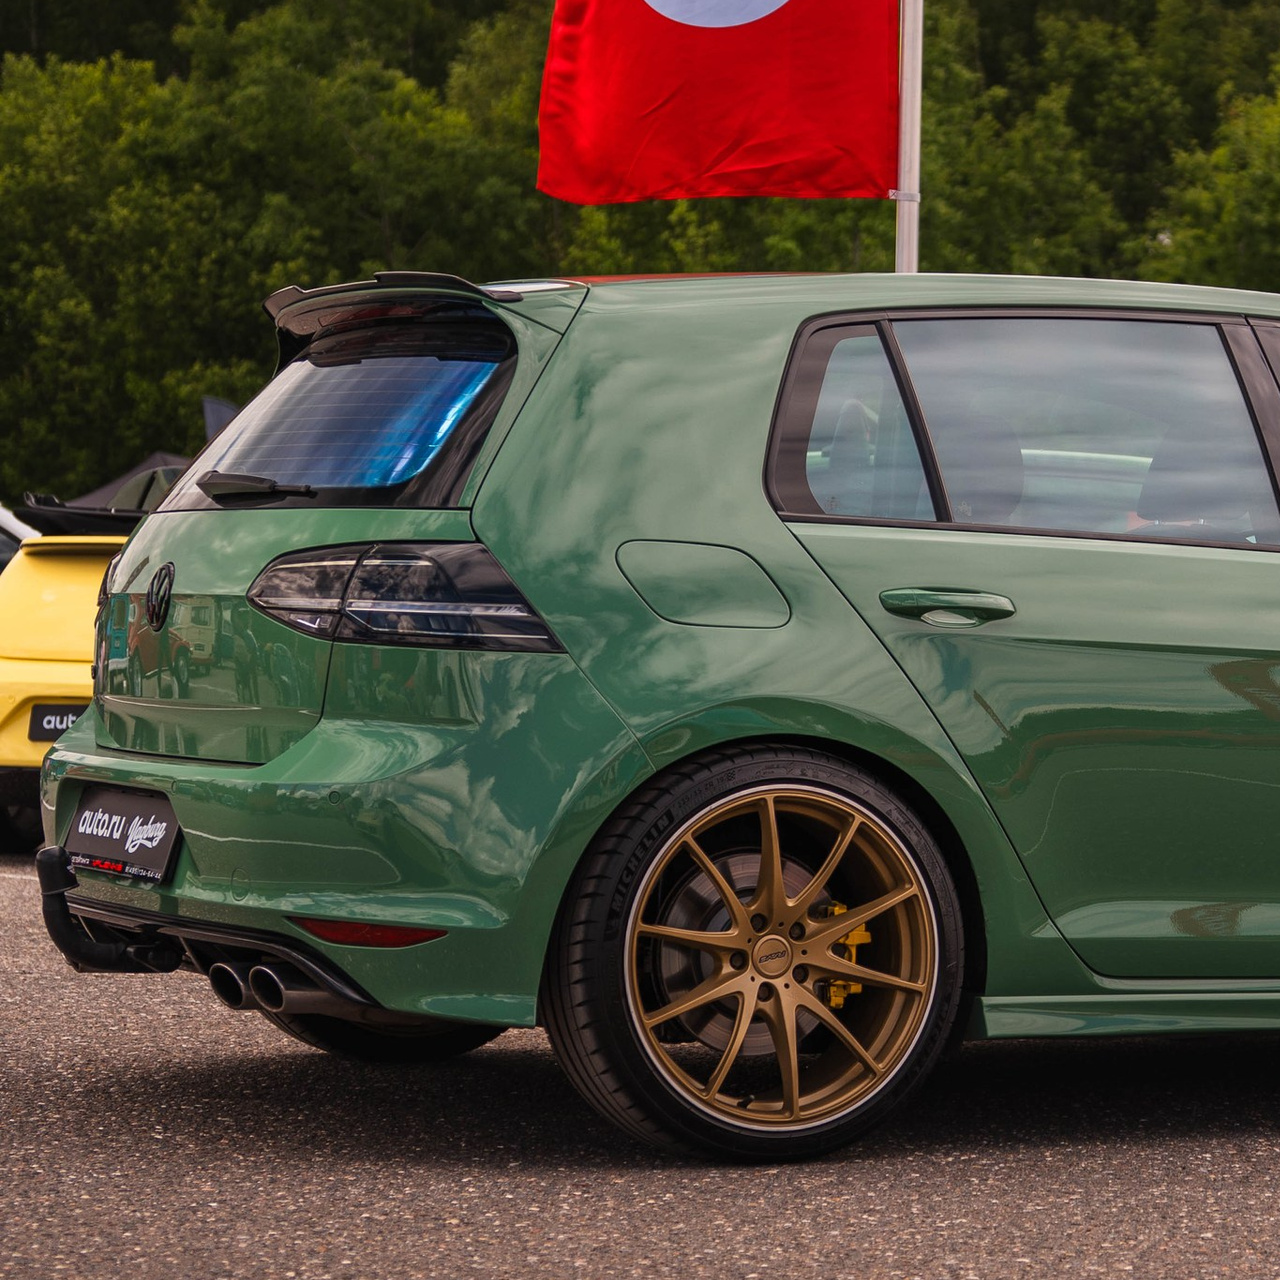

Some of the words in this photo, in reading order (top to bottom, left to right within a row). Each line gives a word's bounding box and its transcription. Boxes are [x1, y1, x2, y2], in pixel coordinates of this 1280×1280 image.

[42, 713, 77, 730] aut
[78, 808, 126, 839] auto.ru
[611, 812, 671, 912] MICHELIN
